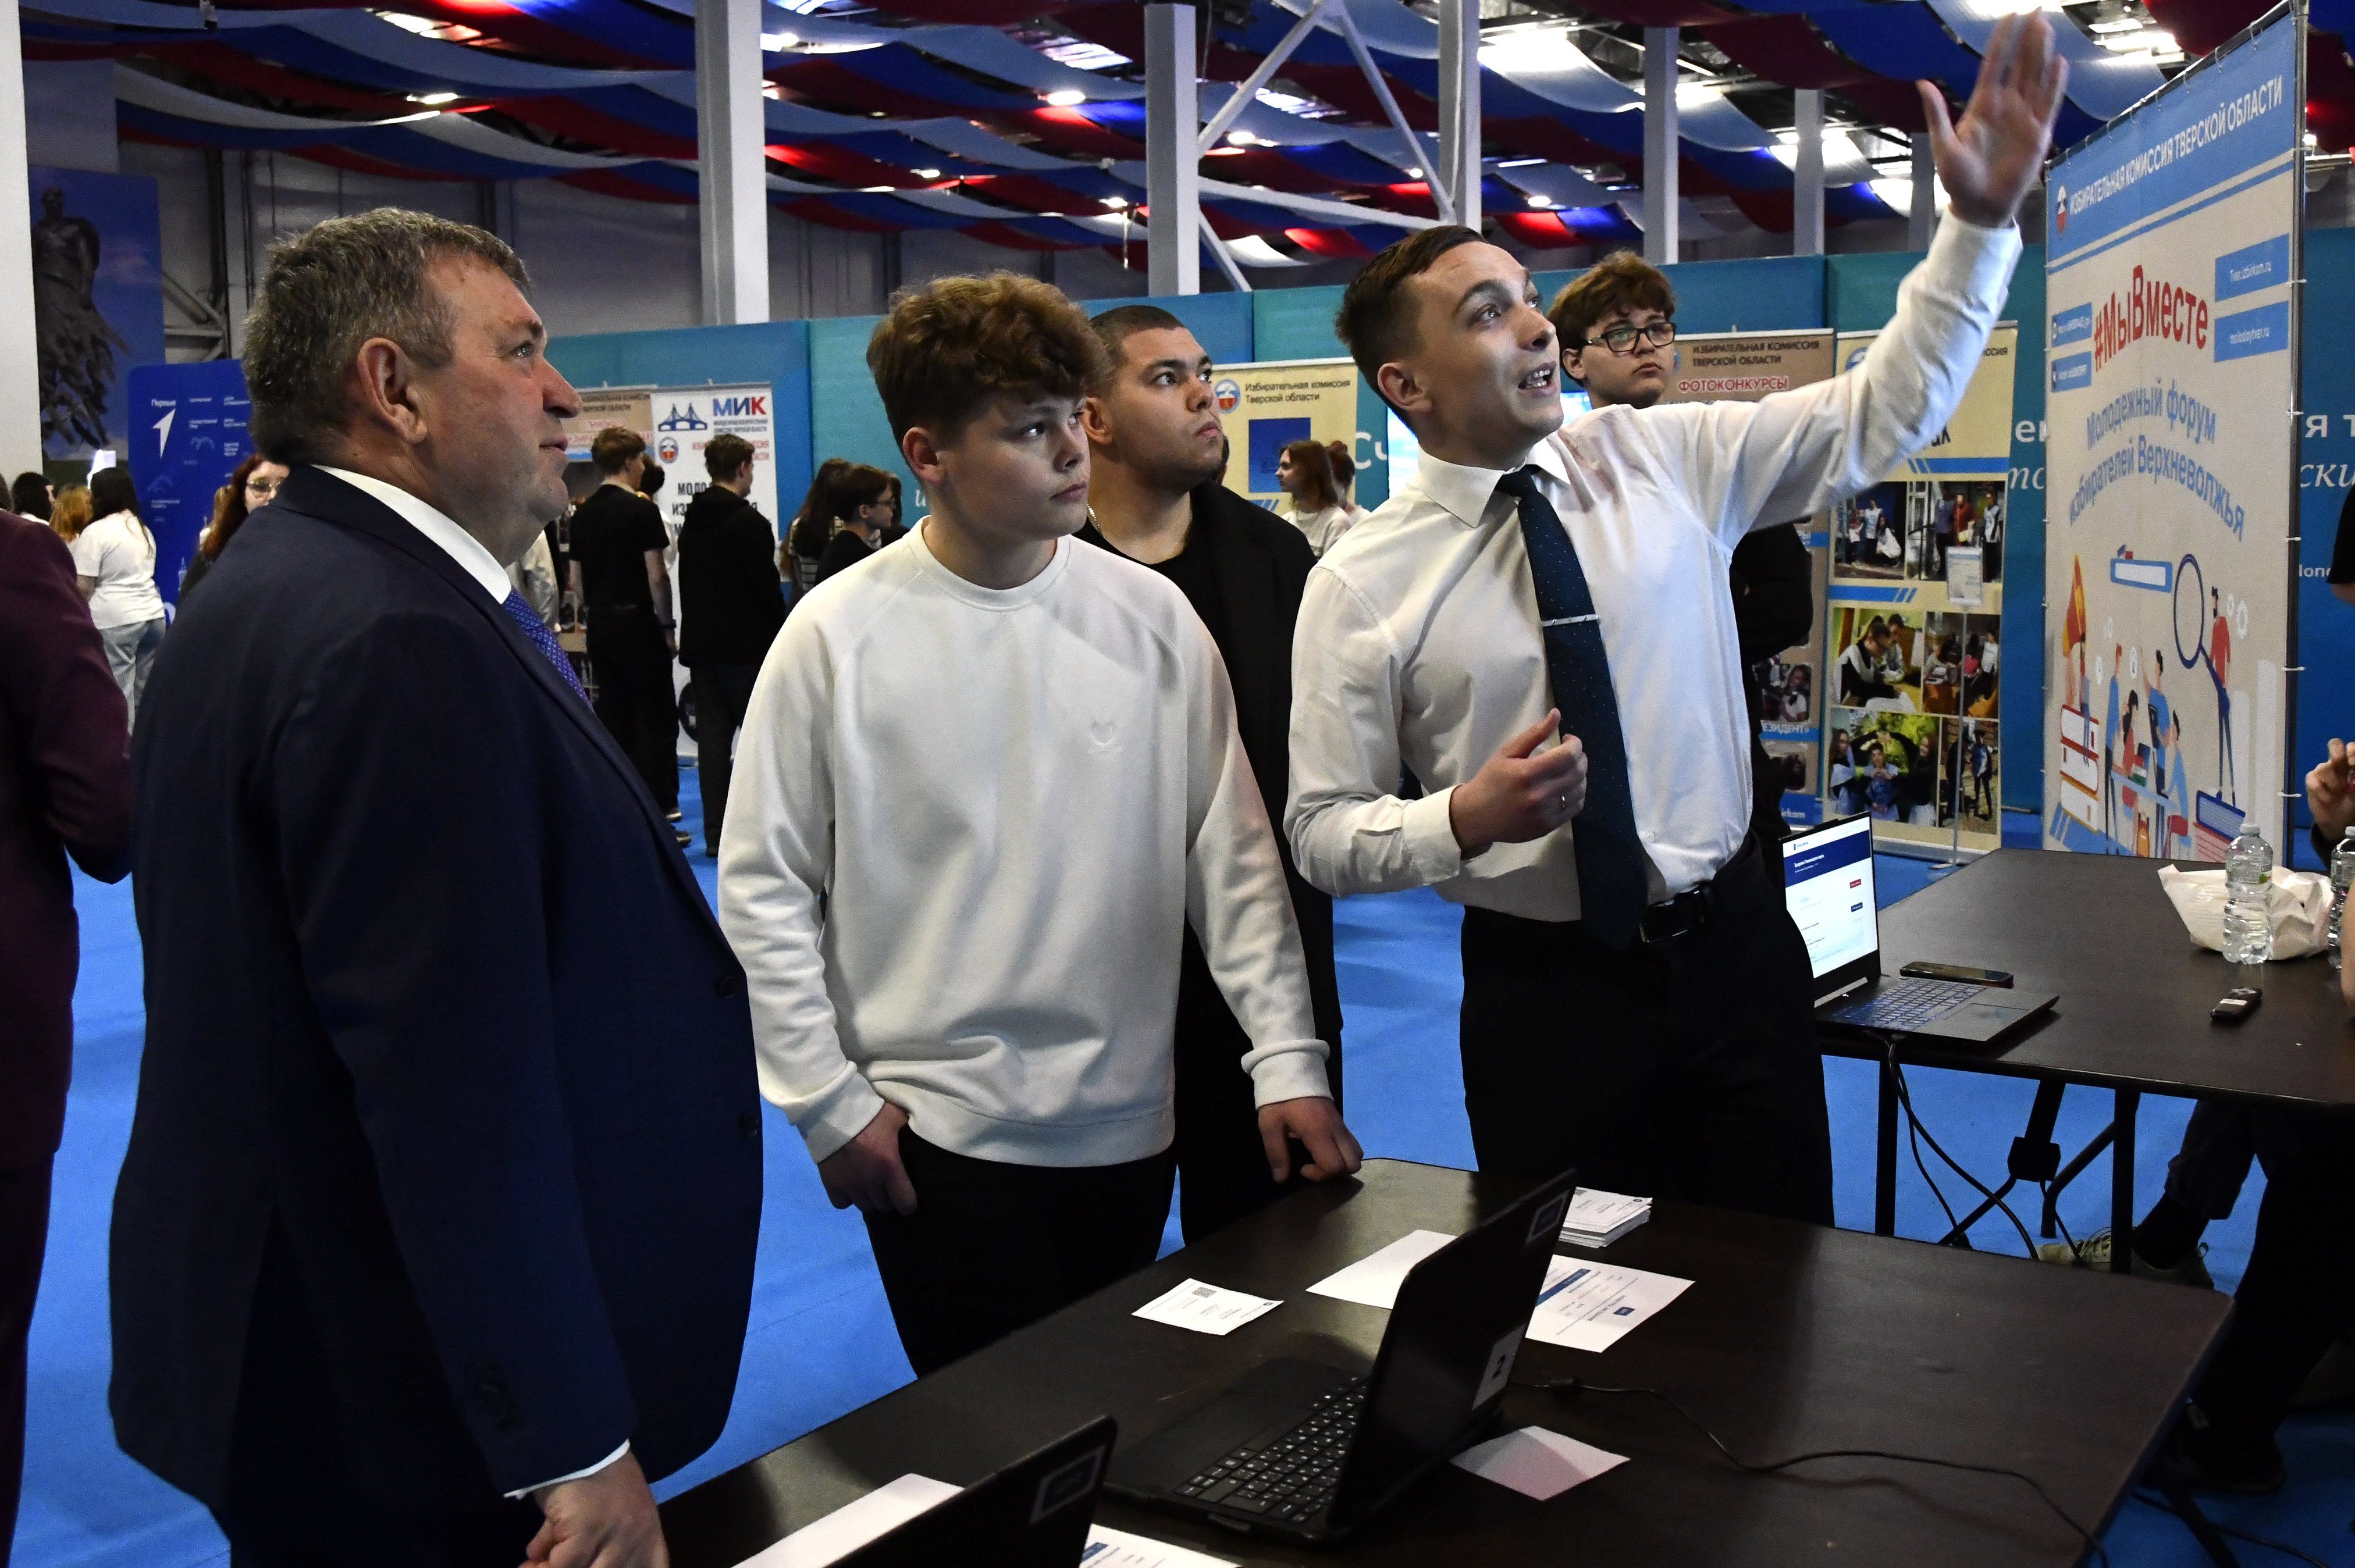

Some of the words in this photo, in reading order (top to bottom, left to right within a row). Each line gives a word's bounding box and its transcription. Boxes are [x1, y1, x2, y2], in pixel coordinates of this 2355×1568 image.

[2125, 137, 2173, 183] КОМИССИЯ
[2175, 102, 2226, 160] ТВЕРСКОЙ
[2228, 74, 2283, 131] ОБЛАСТИ
[2094, 265, 2208, 372] #МыВместе
[1693, 343, 1765, 354] ИЗБИРАТЕЛЬНАЯ
[1767, 341, 1820, 350] КОМИССИЯ
[1693, 354, 1737, 366] ТВЕРСКОЙ
[1739, 355, 1781, 365] ОБЛАСТИ
[1245, 382, 1309, 392] Избирательная
[1311, 380, 1351, 389] комиссия
[1678, 377, 1788, 392] ФОТОКОНКУРСЫ
[713, 397, 767, 416] МИК
[1245, 393, 1283, 404] Тверской
[1285, 392, 1320, 402] области
[2167, 379, 2216, 444] форум
[2138, 434, 2244, 542] Верхневолжья
[1492, 1355, 1506, 1380] 2
